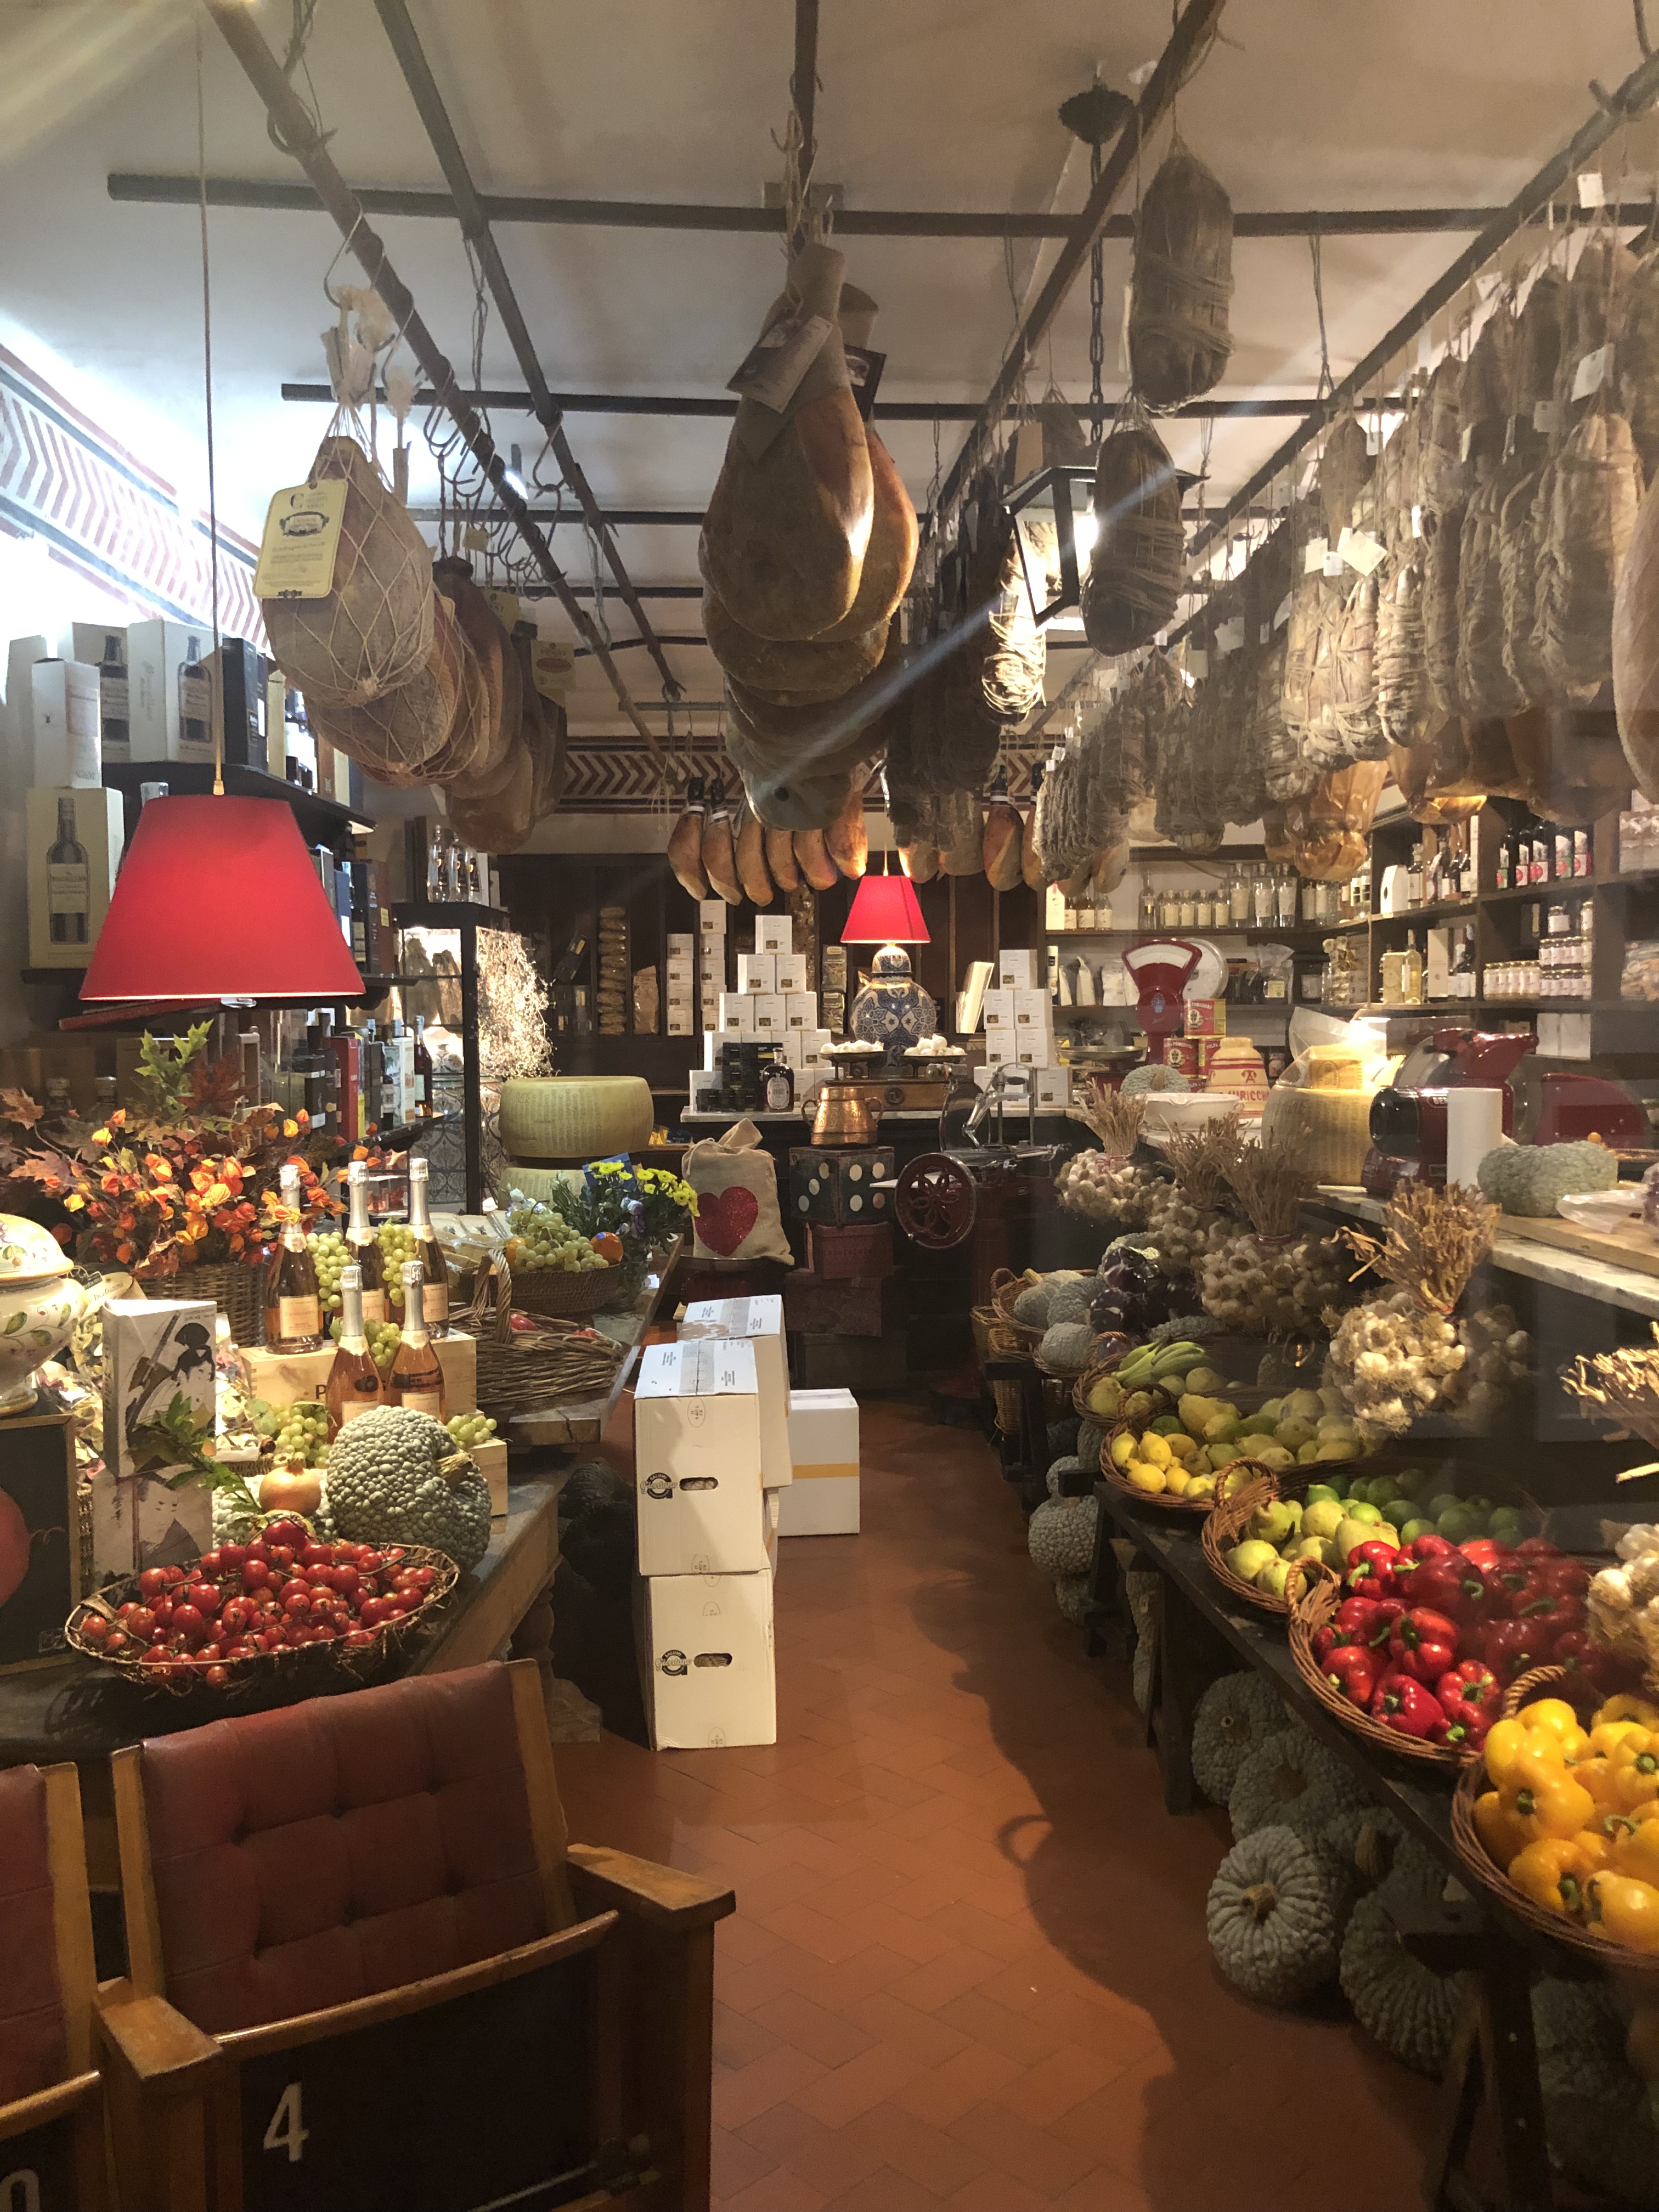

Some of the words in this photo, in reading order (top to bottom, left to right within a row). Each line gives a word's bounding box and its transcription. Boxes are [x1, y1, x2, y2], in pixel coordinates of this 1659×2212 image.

[639, 1480, 678, 1494] Giordano
[664, 1650, 682, 1658] SALUMI
[263, 2081, 309, 2163] 4
